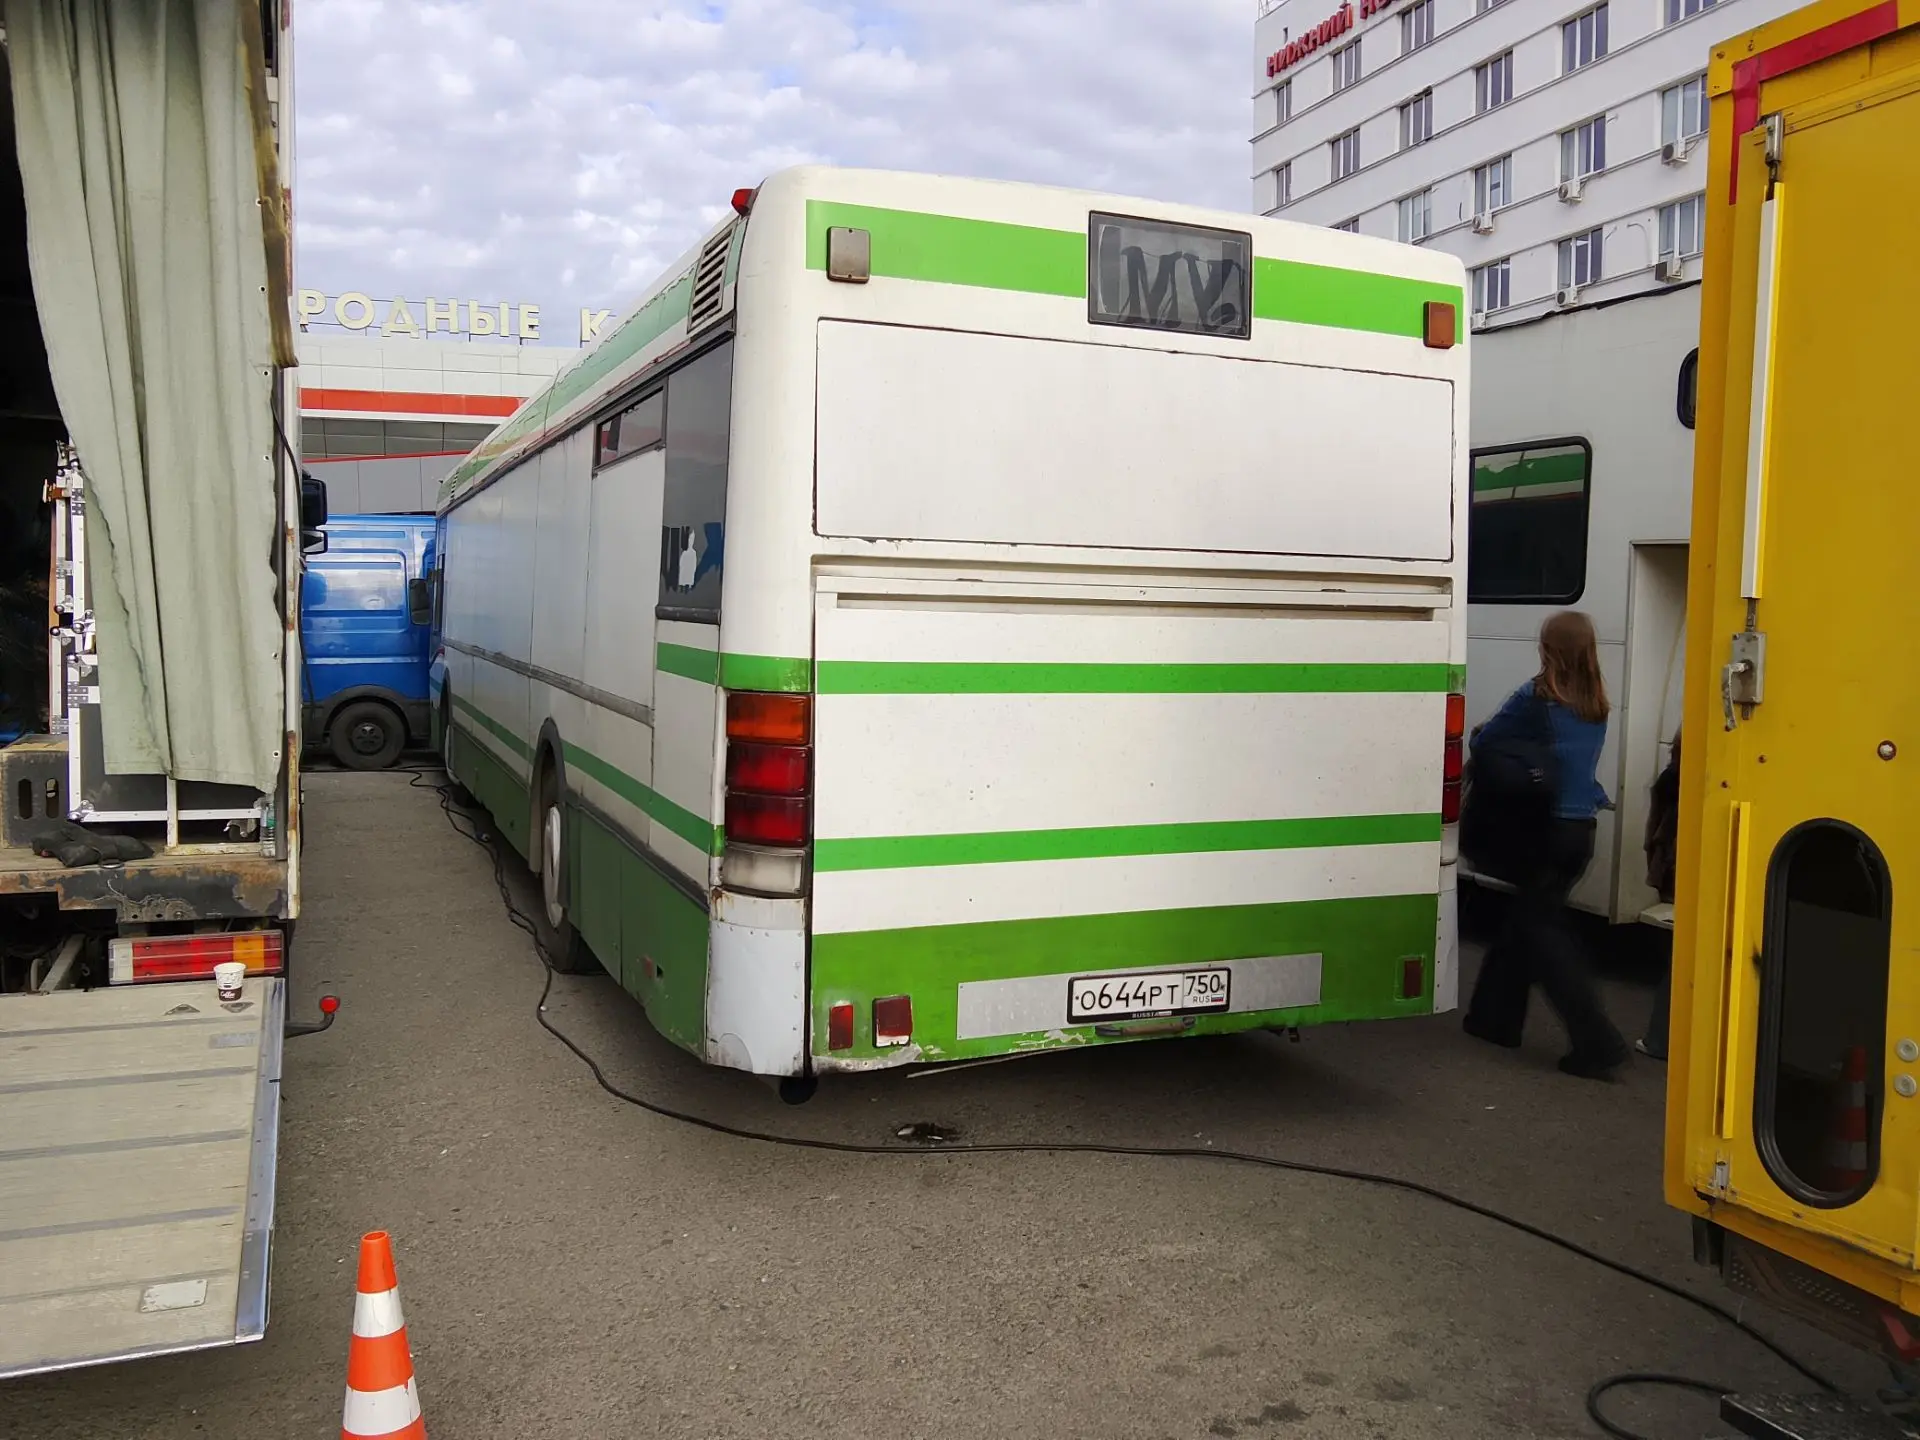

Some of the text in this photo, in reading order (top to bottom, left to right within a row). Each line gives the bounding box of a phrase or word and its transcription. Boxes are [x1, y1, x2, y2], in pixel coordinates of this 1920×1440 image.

[1267, 3, 1353, 78] НИЖНИЙ
[298, 289, 612, 342] РОДНЫЕ К
[1185, 974, 1221, 996] 750
[1192, 995, 1210, 1004] RUS
